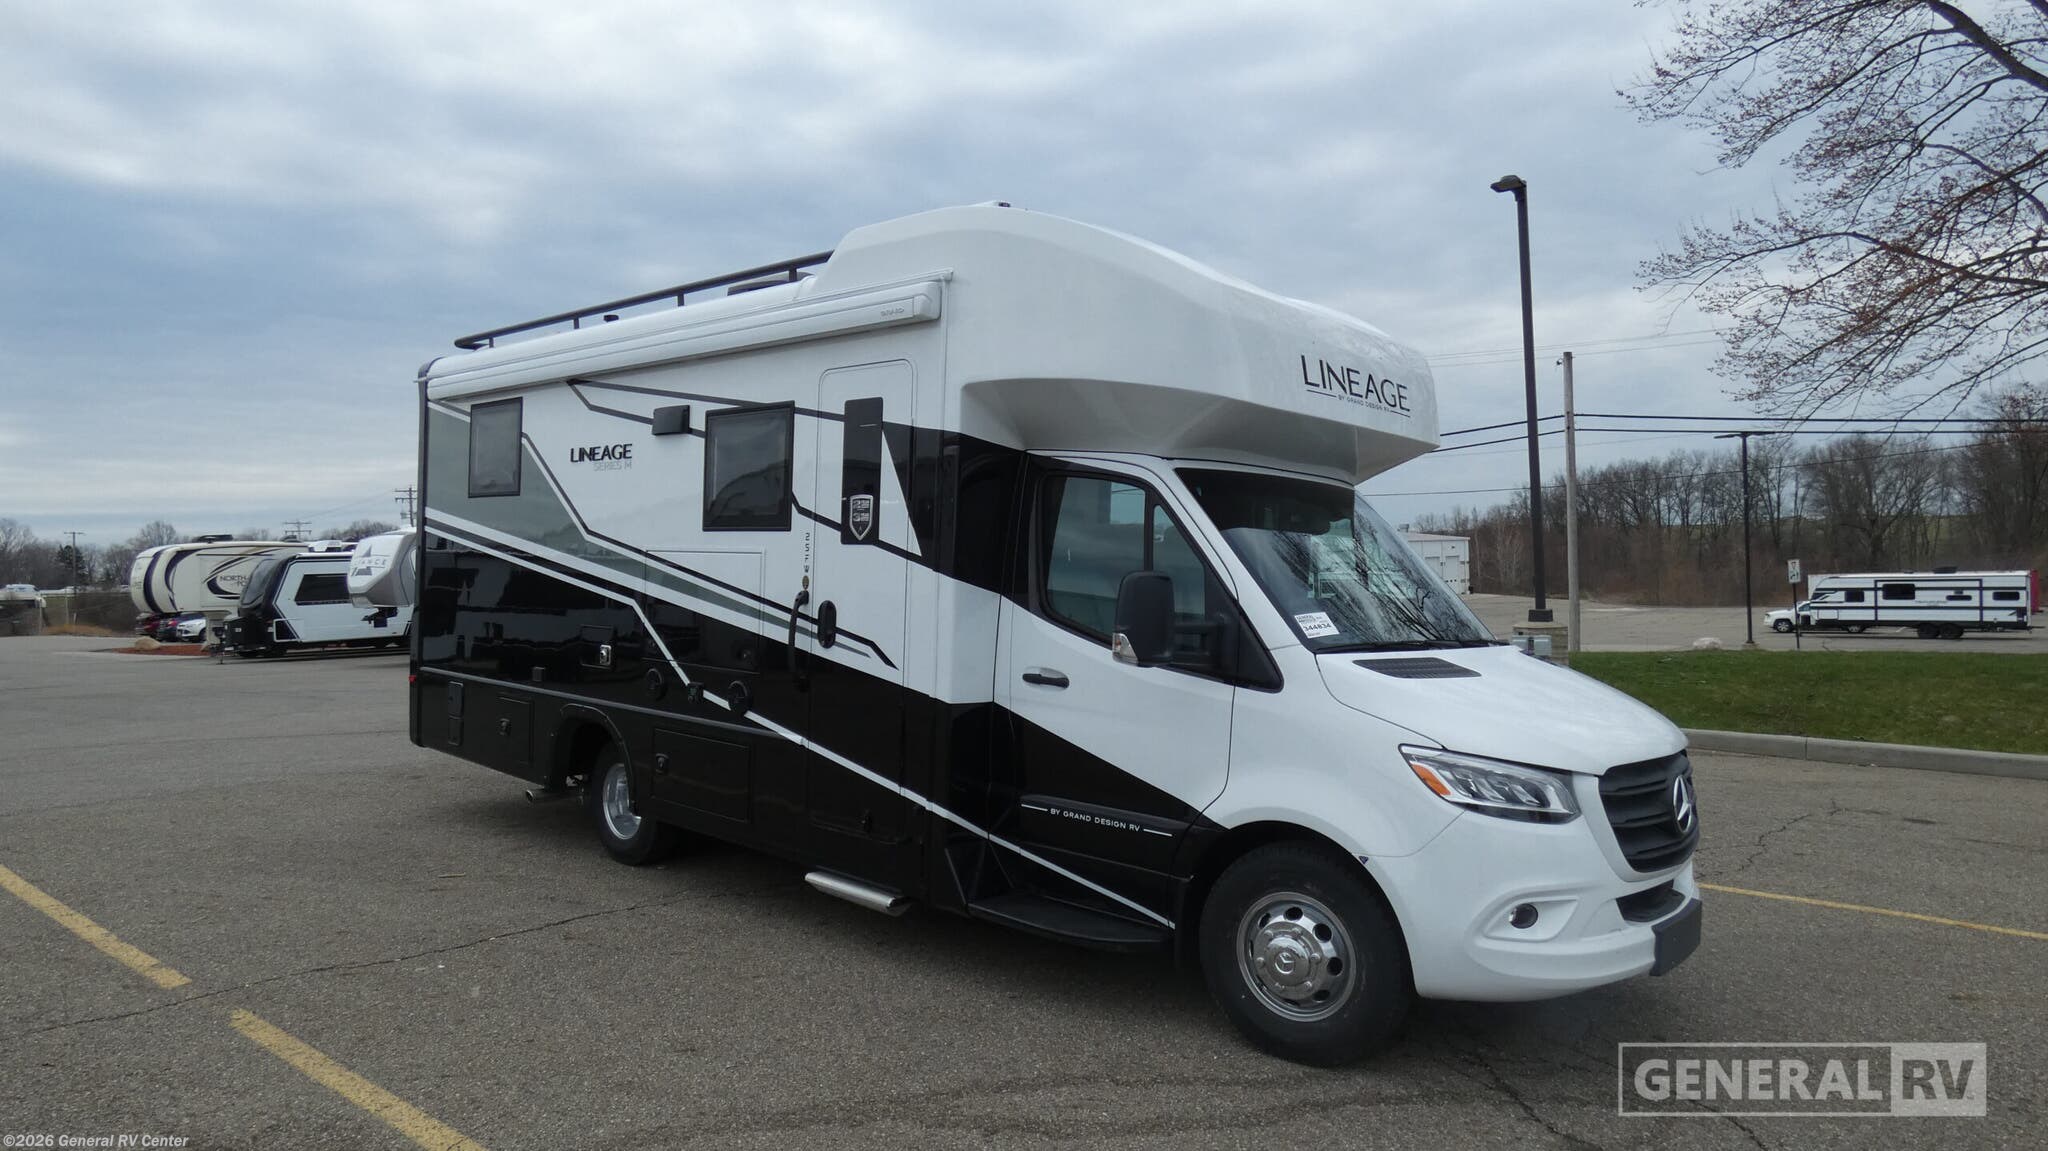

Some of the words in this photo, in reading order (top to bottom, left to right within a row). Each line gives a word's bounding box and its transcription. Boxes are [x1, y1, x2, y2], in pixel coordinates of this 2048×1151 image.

[1301, 354, 1410, 413] LINEAGE
[570, 443, 633, 463] LINEAGE
[1050, 808, 1061, 816] BY
[1063, 811, 1092, 822] GRAND
[1094, 817, 1127, 829] DESIGN
[1129, 824, 1141, 832] RV
